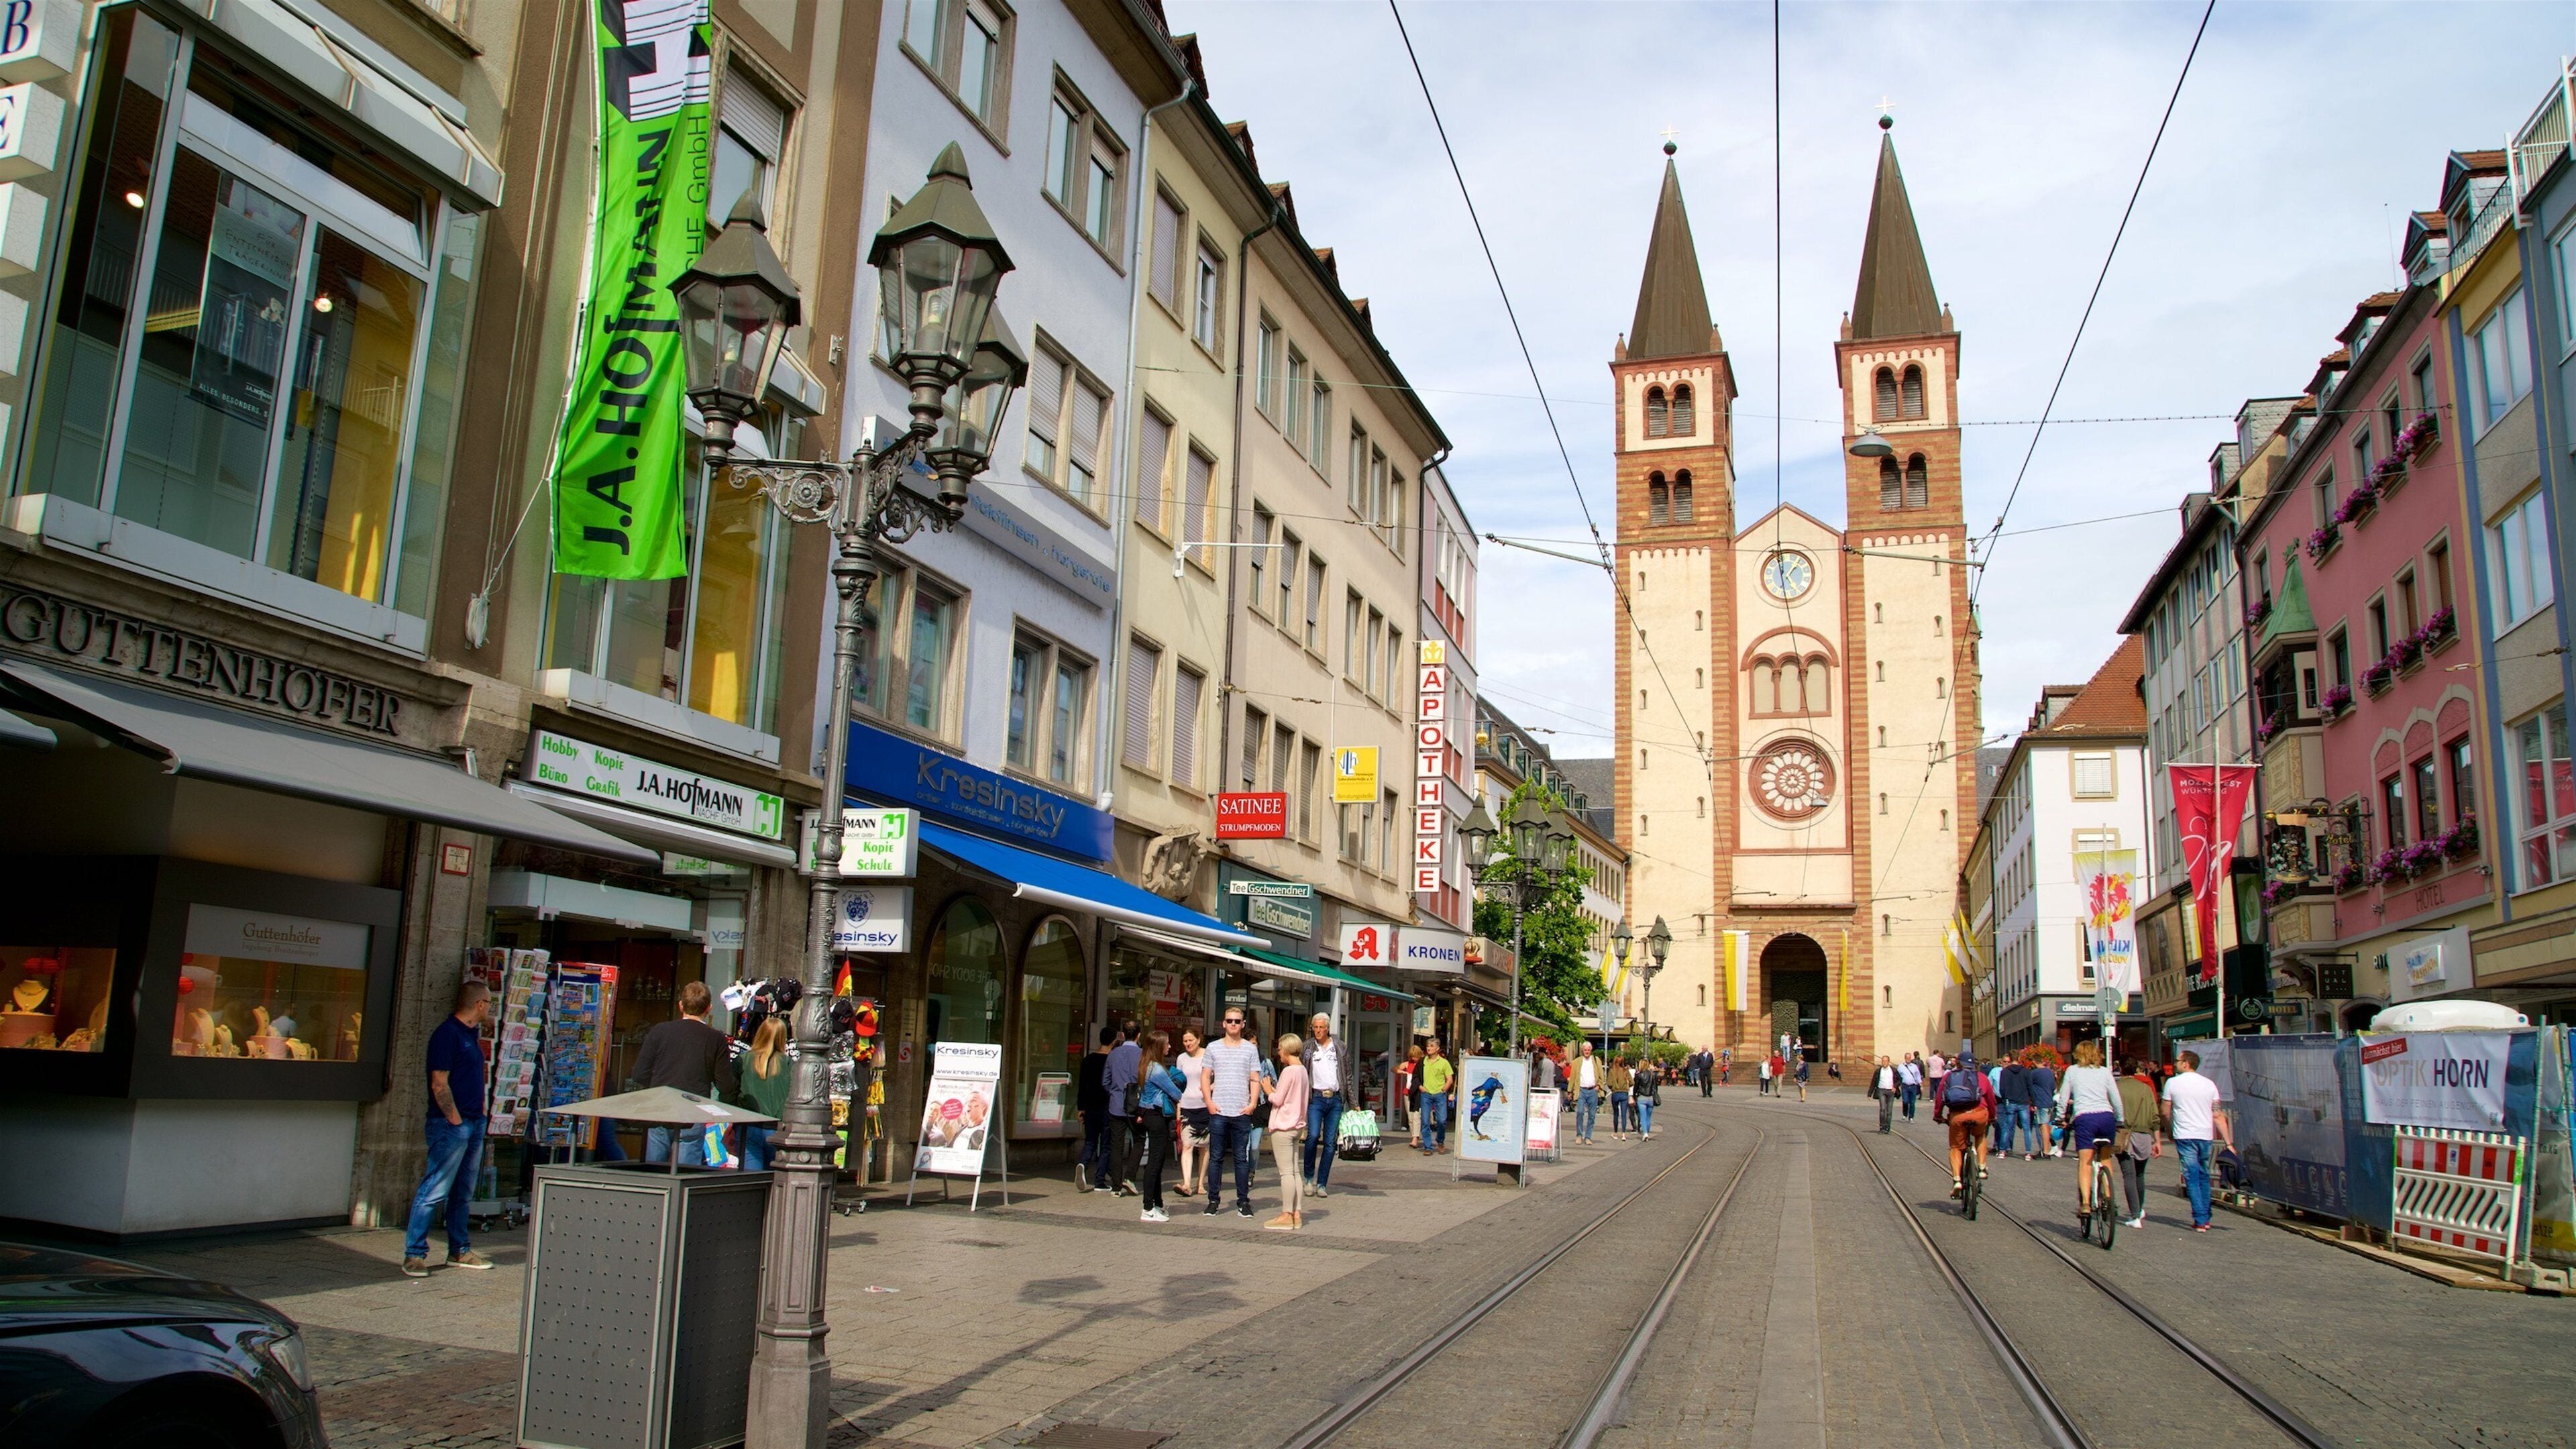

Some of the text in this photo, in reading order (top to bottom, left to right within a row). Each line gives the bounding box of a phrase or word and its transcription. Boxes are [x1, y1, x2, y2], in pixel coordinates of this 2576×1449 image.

[687, 116, 707, 203] GmbH
[222, 394, 262, 415] BESONDERS.
[5, 594, 402, 737] GUTTENHÖFER
[542, 735, 624, 771] Hobby Kopie
[1417, 670, 1442, 889] APOTHEKE
[917, 751, 1065, 839] Kresinsky
[1220, 798, 1282, 814] SATINEE
[1219, 823, 1281, 832] STRUMPFMODEN
[863, 841, 894, 854] Kopie
[2326, 833, 2352, 845] Hotel
[1232, 883, 1307, 896] Tee Gschwendner
[2415, 883, 2445, 912] HOTEL
[1252, 899, 1311, 933] Tee Gschwendner
[243, 922, 321, 945] Guttenhöfer
[1409, 945, 1460, 962] KRONEN
[2269, 1006, 2298, 1014] HOTEL
[936, 1046, 999, 1059] Kresinsky
[2434, 1059, 2489, 1088] HORN
[2375, 1097, 2393, 1108] HAUS
[2396, 1097, 2408, 1108] DER
[2411, 1098, 2437, 1109] FEINEN
